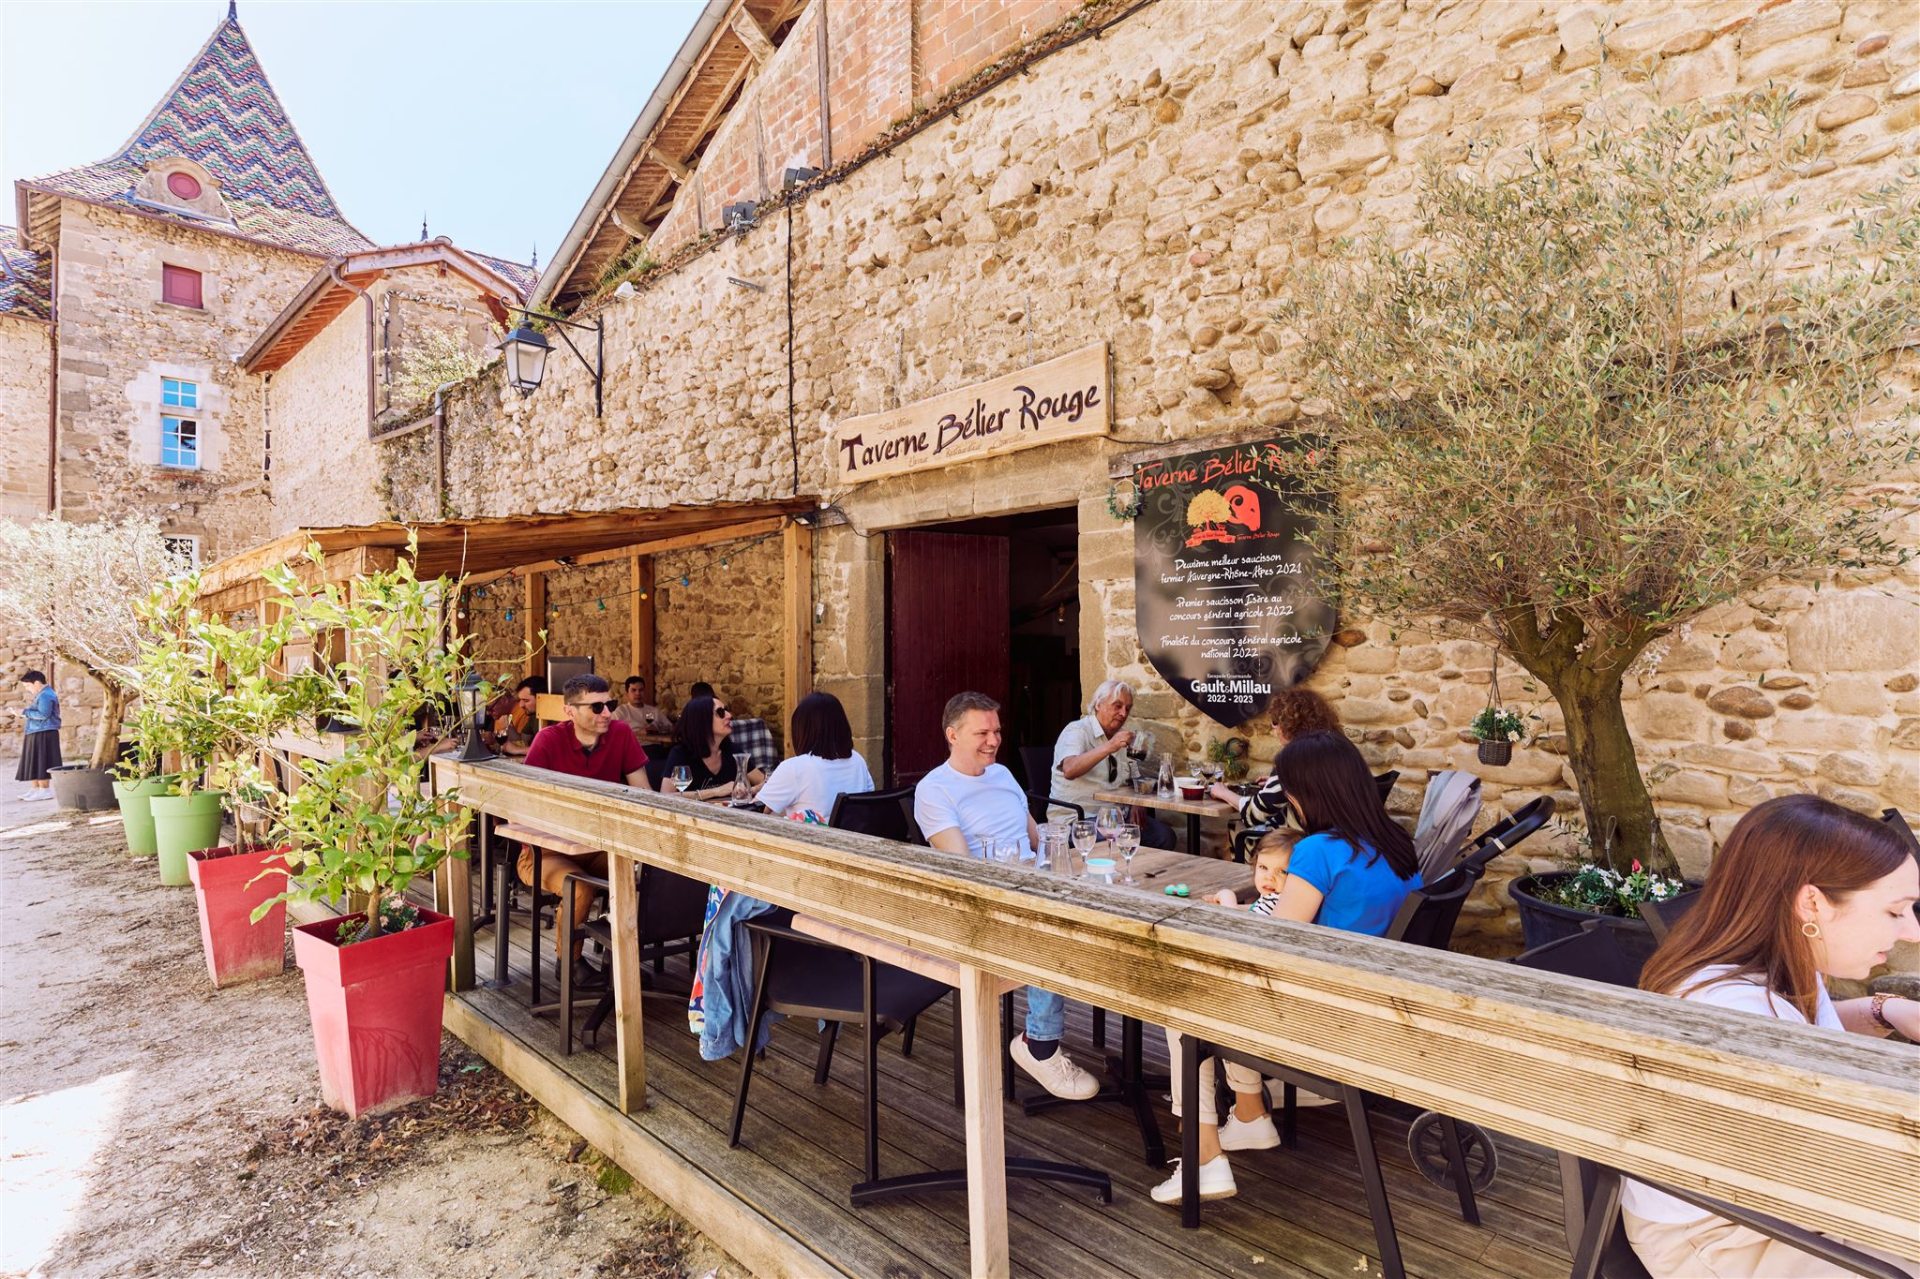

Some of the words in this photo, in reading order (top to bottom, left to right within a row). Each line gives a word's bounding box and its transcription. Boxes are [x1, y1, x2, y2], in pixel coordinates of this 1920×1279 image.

[840, 430, 929, 472] Taverne
[933, 399, 1011, 455] Bélier
[1013, 385, 1101, 431] Rouge
[1135, 463, 1198, 489] Taverne
[1201, 450, 1260, 483] Bélier
[1211, 554, 1239, 567] meilleur
[1241, 553, 1281, 564] saucisson
[1276, 562, 1302, 575] 2021
[1176, 596, 1204, 608] Premier
[1206, 595, 1244, 606] saucisson
[1271, 595, 1282, 603] au
[1169, 612, 1201, 621] concours
[1203, 607, 1232, 621] général
[1234, 606, 1264, 620] agricole
[1265, 605, 1294, 616] 2022
[1160, 635, 1189, 648] Finaliste
[1190, 635, 1200, 646] du
[1201, 638, 1236, 646] concours
[1237, 633, 1269, 647] général
[1270, 632, 1302, 646] agricole
[1201, 647, 1231, 658] national
[1232, 648, 1259, 658] 2022
[1207, 694, 1227, 704] 2022
[1233, 694, 1254, 704] 2023
